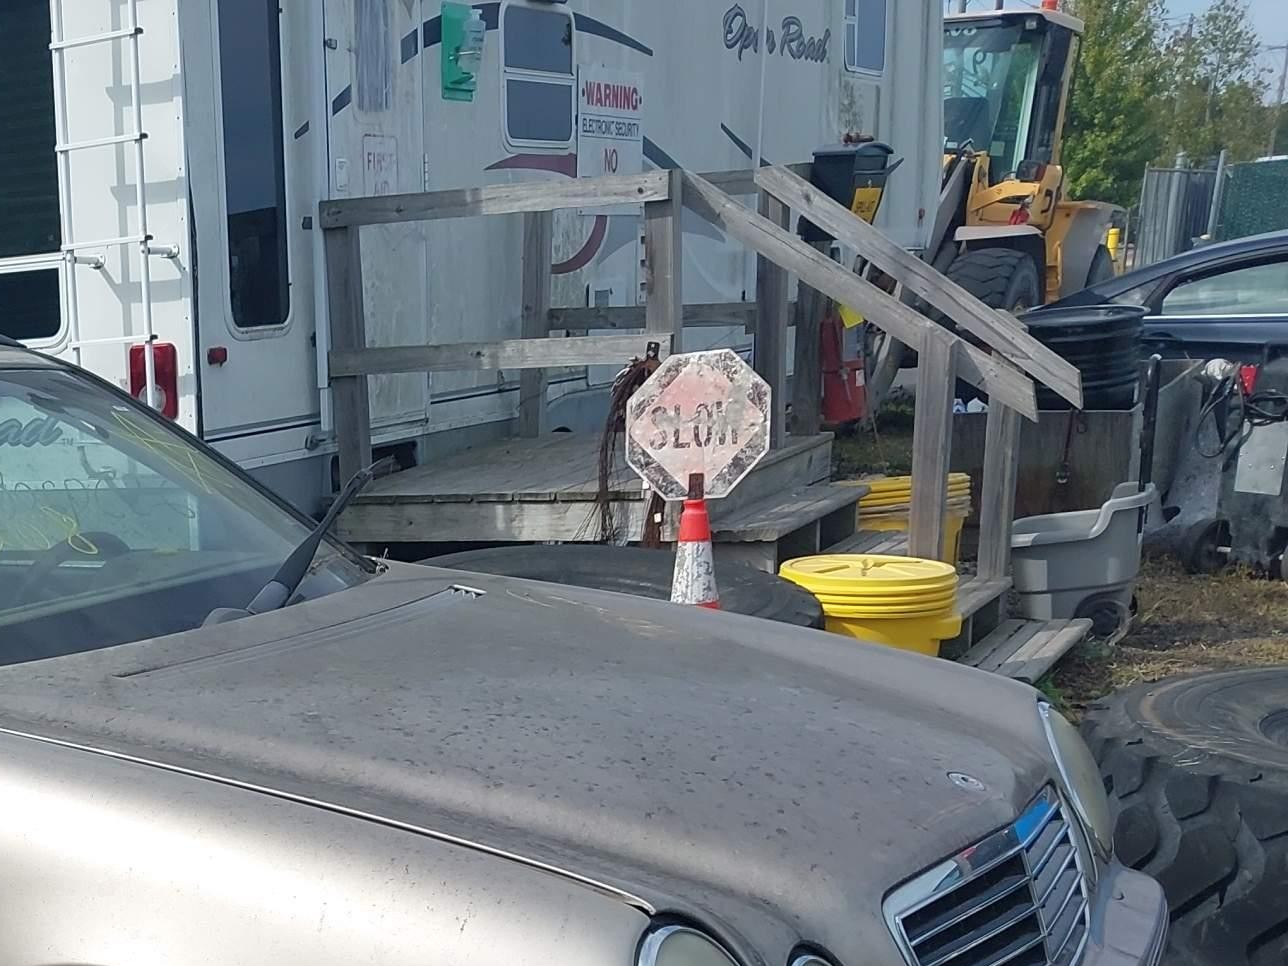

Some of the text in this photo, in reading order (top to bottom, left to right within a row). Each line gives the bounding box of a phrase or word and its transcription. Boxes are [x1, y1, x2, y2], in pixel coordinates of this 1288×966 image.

[722, 3, 831, 63] Open Road
[585, 80, 639, 111] WARNING
[582, 118, 639, 137] ELECTRONIC SECURITY
[604, 148, 618, 173] NO
